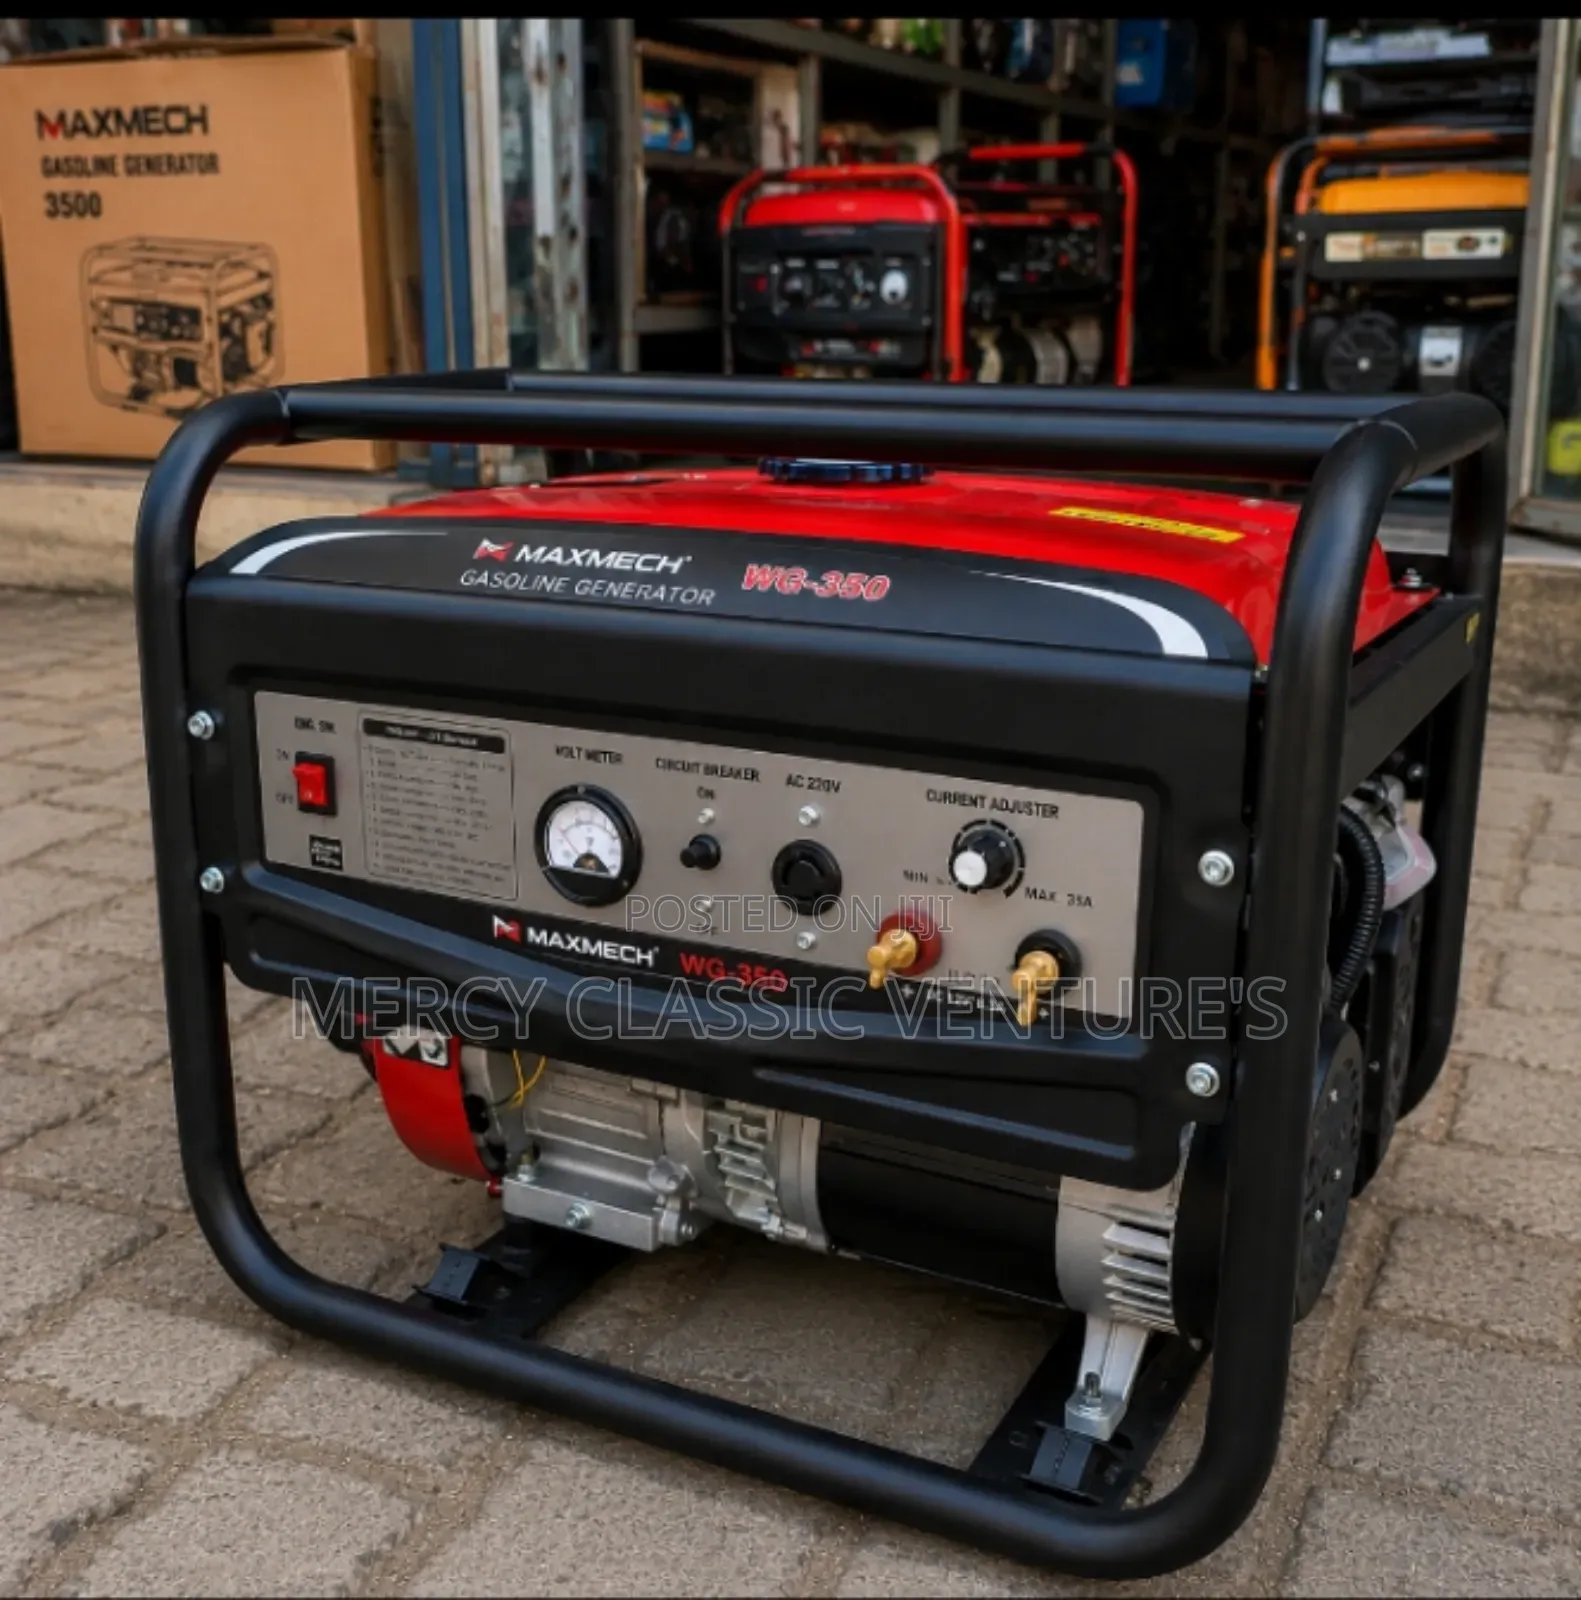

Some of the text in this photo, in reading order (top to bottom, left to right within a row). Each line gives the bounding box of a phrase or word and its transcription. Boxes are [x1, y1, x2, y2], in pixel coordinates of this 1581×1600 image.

[35, 103, 209, 140] MAXMECH
[40, 151, 220, 179] GASOLINE GENERATOR
[44, 190, 103, 219] 3500
[515, 543, 693, 575] MAXMECH
[459, 568, 716, 608] GASOLINE GENERATOR
[741, 562, 892, 602] WG-350
[555, 745, 624, 765] VOLT METER
[655, 757, 761, 783] CIRCUIT BREAKER
[785, 773, 842, 794] AC 220V
[926, 788, 1060, 819] CURRENT ADJUSTER
[527, 926, 655, 967] MAXMECH
[679, 952, 788, 993] WG-350
